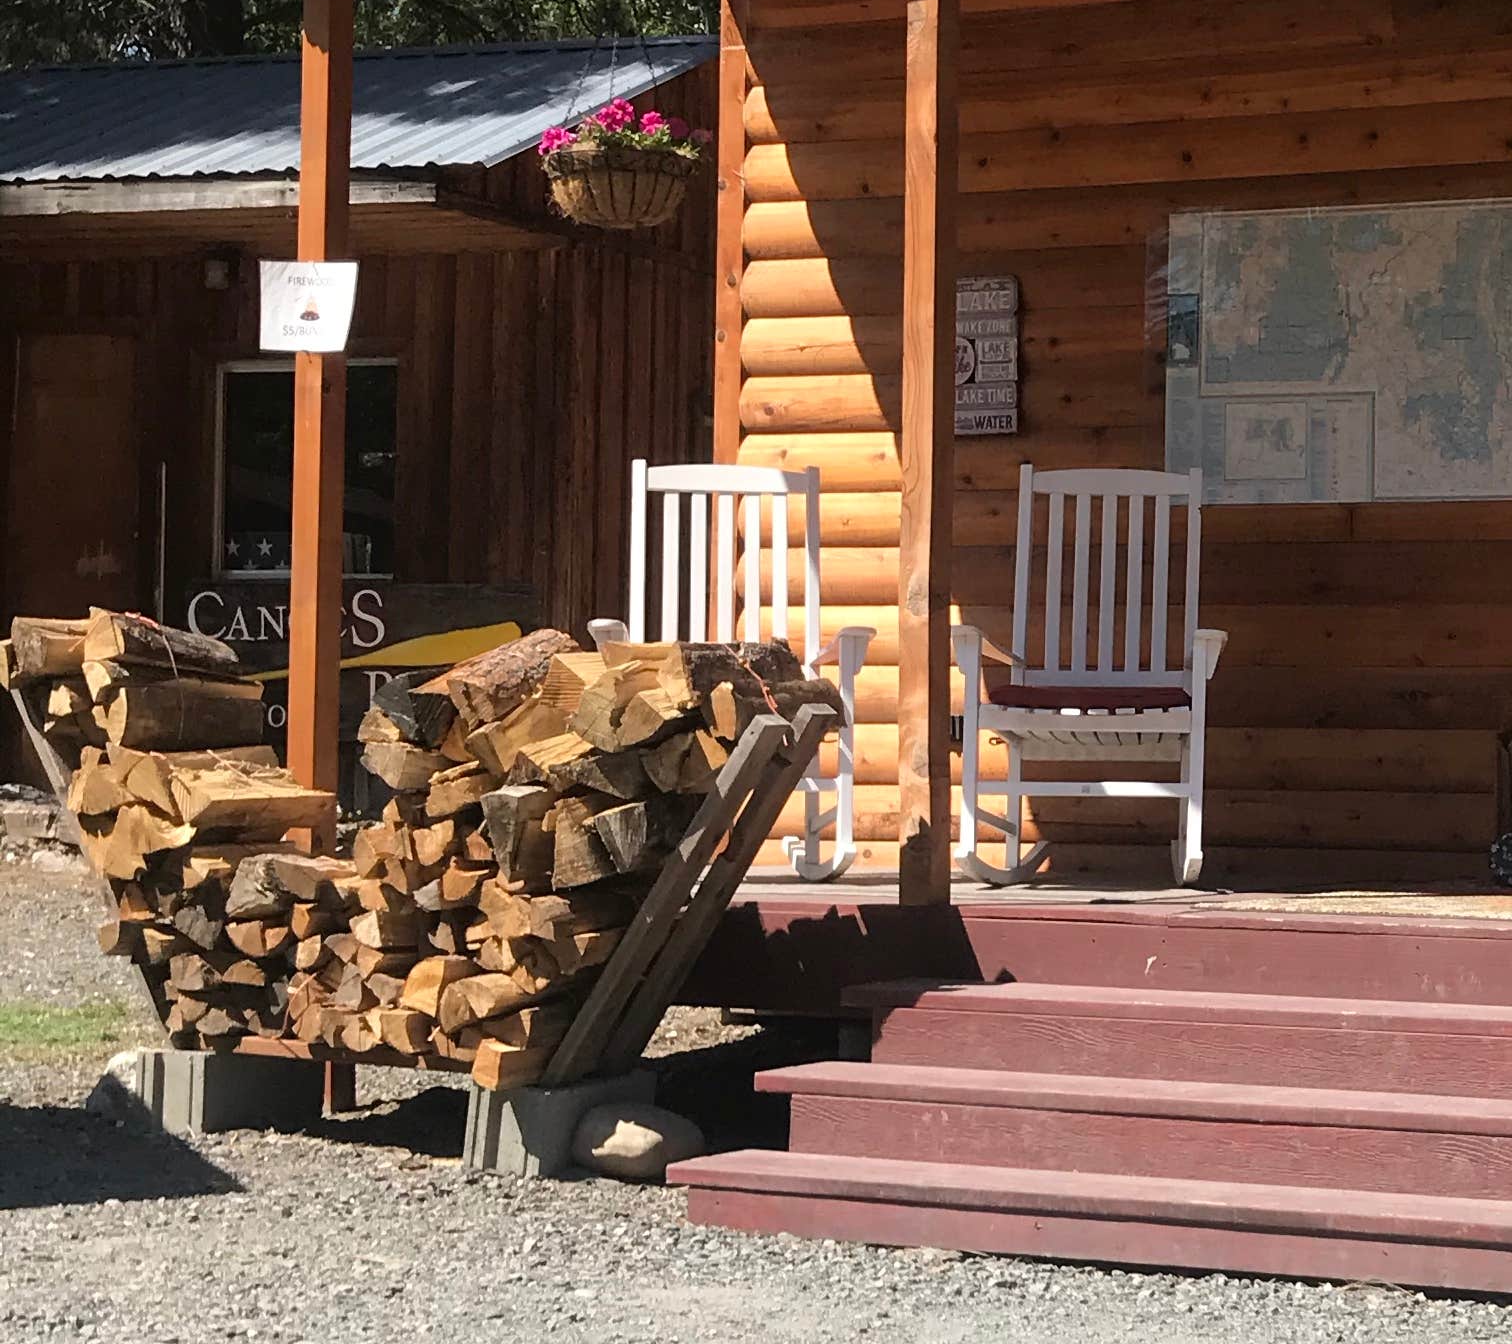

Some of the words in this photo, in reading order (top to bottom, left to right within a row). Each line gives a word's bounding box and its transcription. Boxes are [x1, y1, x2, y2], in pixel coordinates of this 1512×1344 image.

[956, 388, 985, 404] LAKE
[987, 388, 1013, 404] TIME
[974, 415, 1013, 430] WATER
[187, 589, 385, 648] CANS
